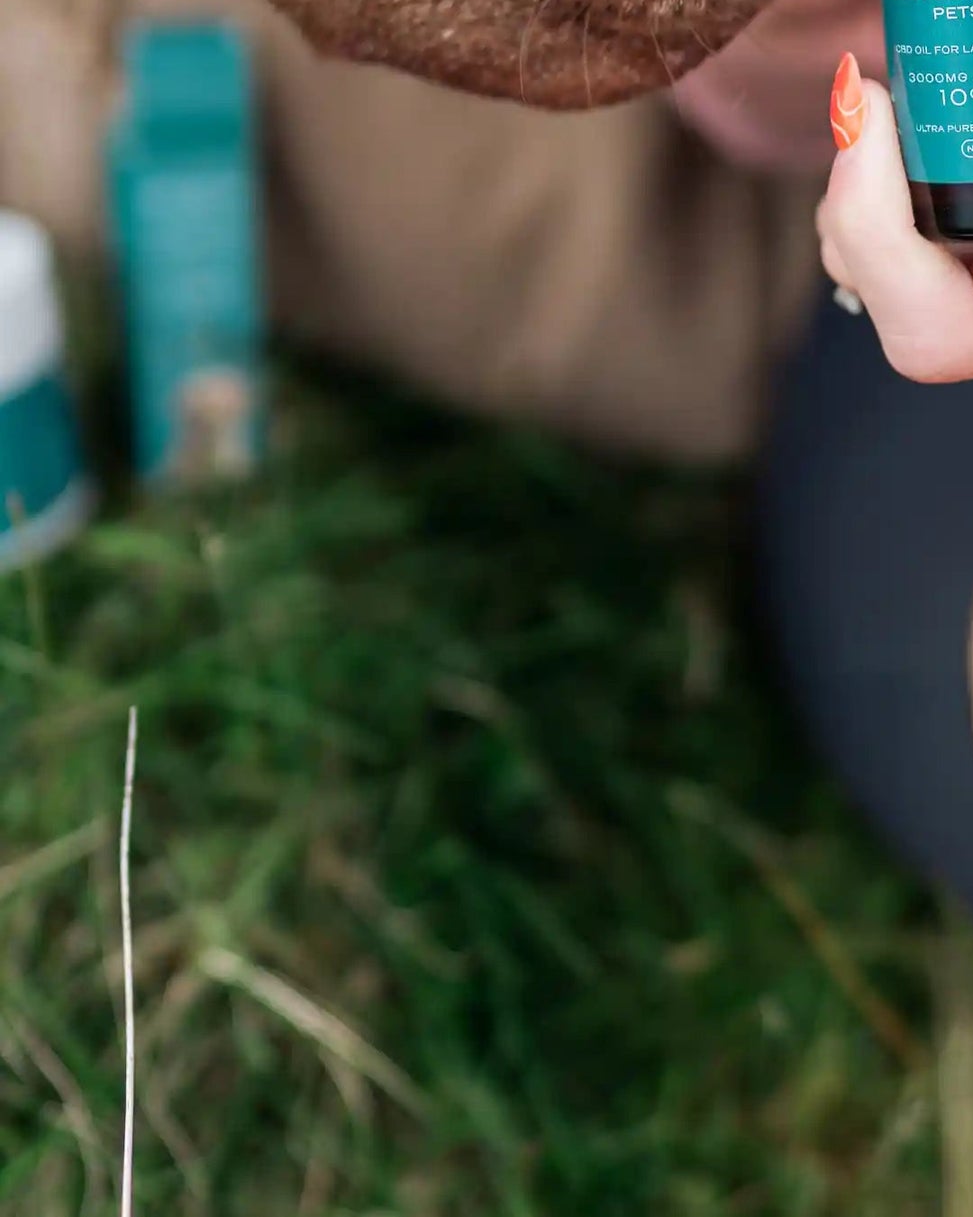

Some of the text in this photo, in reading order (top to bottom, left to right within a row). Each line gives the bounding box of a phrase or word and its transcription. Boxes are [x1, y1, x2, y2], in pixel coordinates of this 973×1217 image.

[896, 43, 913, 54] CBD
[914, 43, 932, 55] OIL
[934, 41, 960, 55] FOR
[908, 71, 968, 84] 3000MG
[916, 123, 945, 133] ULTRA
